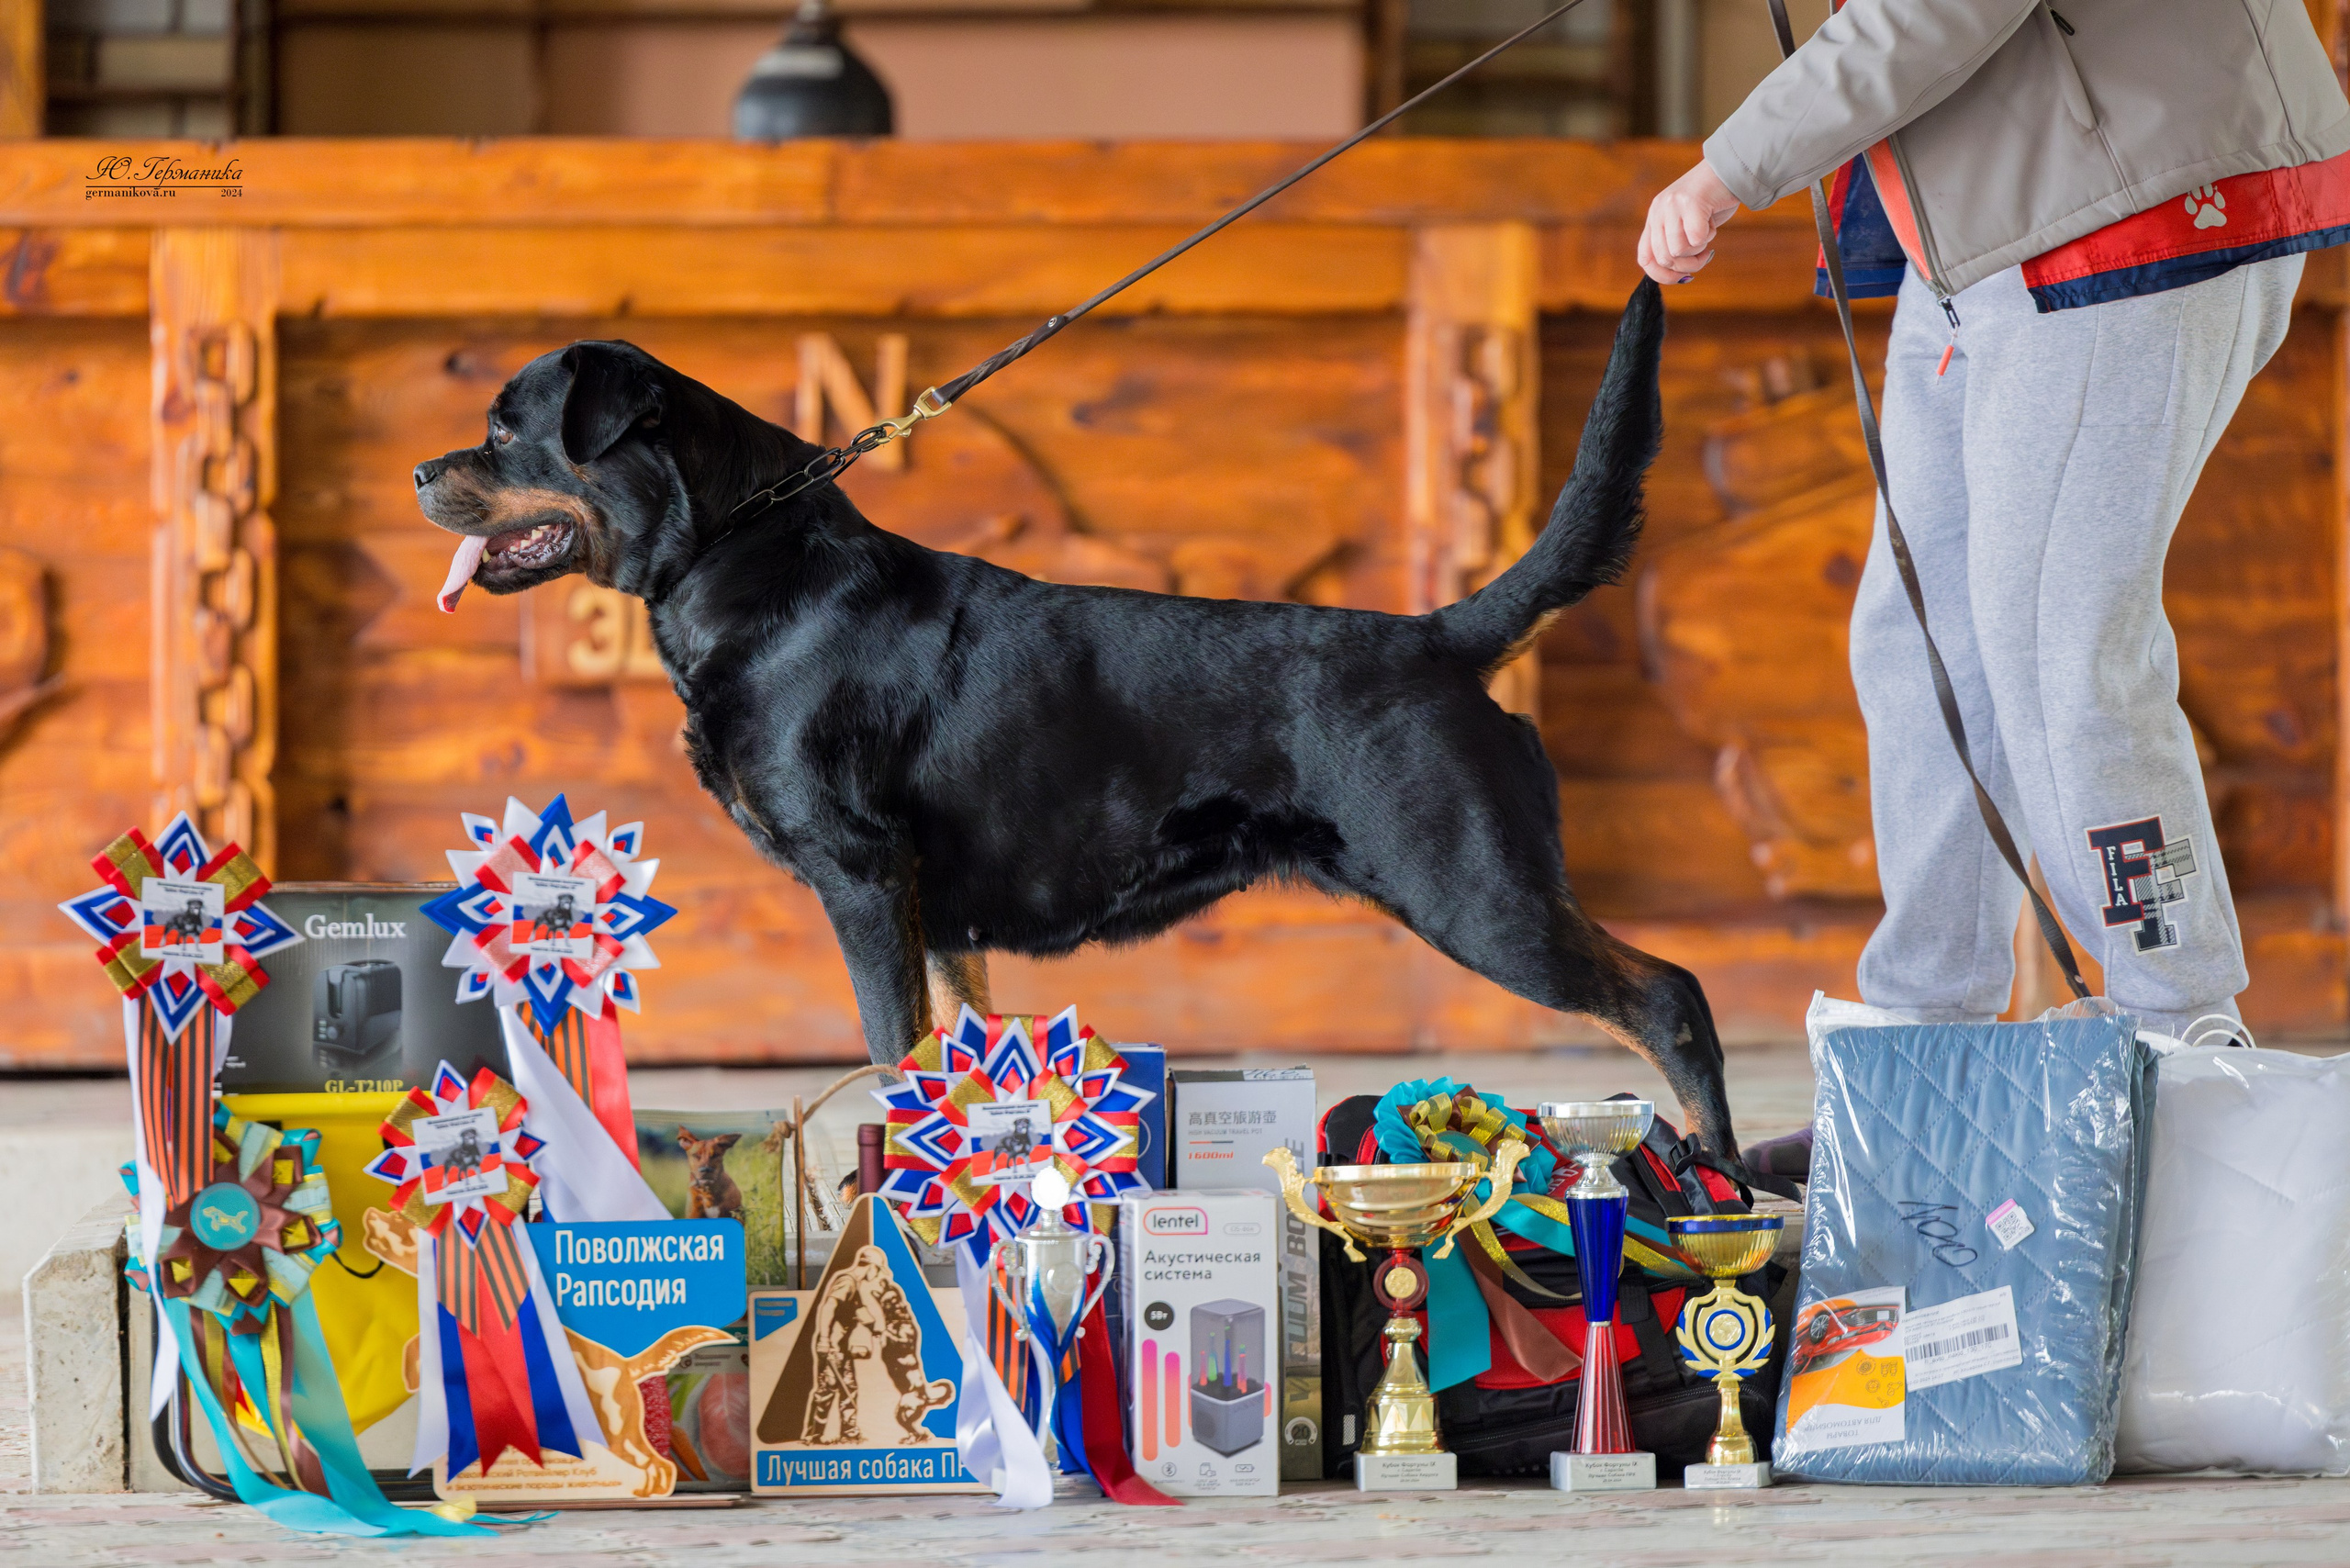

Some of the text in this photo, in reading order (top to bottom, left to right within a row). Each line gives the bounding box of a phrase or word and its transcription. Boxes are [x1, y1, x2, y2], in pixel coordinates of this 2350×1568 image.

[2106, 846, 2129, 907] FILA
[304, 913, 408, 939] Gemlux
[324, 1079, 404, 1092] GL-T210P
[1188, 1150, 1234, 1159] 1600ml
[1153, 1214, 1199, 1228] lentel
[554, 1229, 724, 1265] Поволжская
[1144, 1249, 1261, 1267] Акустическая
[1144, 1270, 1212, 1281] система
[556, 1274, 688, 1311] Рапсодия
[1827, 1428, 1859, 1439] ТОВАРЫ
[767, 1454, 852, 1485] Лучшая
[858, 1451, 934, 1479] собака
